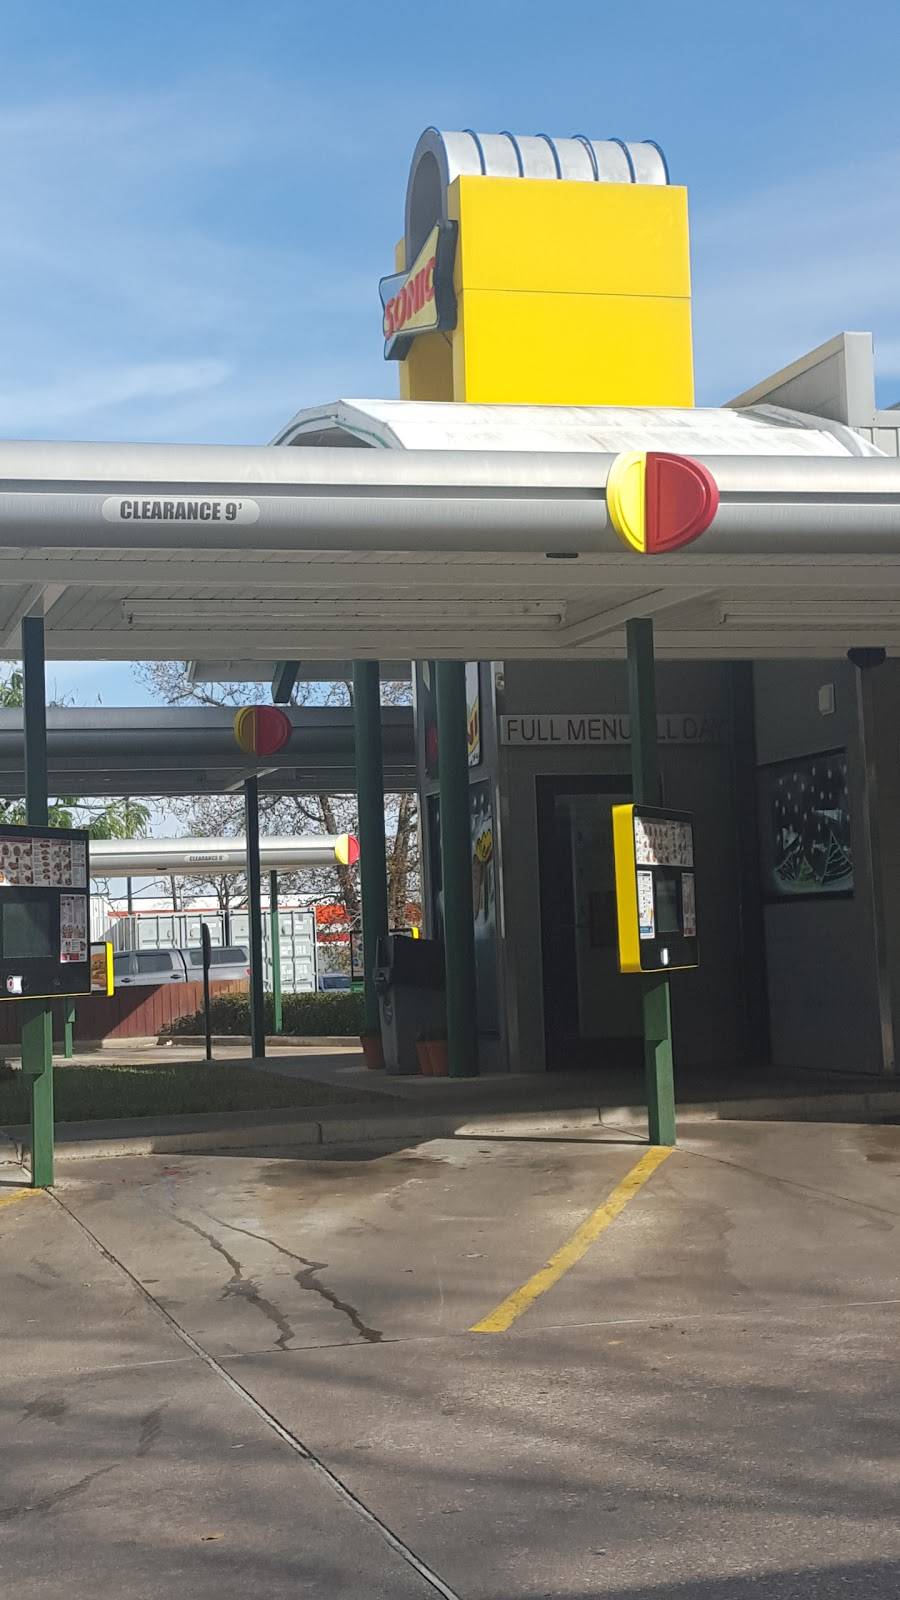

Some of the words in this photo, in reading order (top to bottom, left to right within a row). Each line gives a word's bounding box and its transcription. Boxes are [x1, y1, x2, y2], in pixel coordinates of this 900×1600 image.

[385, 256, 436, 340] SONIC
[120, 500, 221, 520] CLEARANCE
[225, 502, 242, 520] 9'
[507, 719, 561, 741] FULL
[567, 719, 631, 740] MENU
